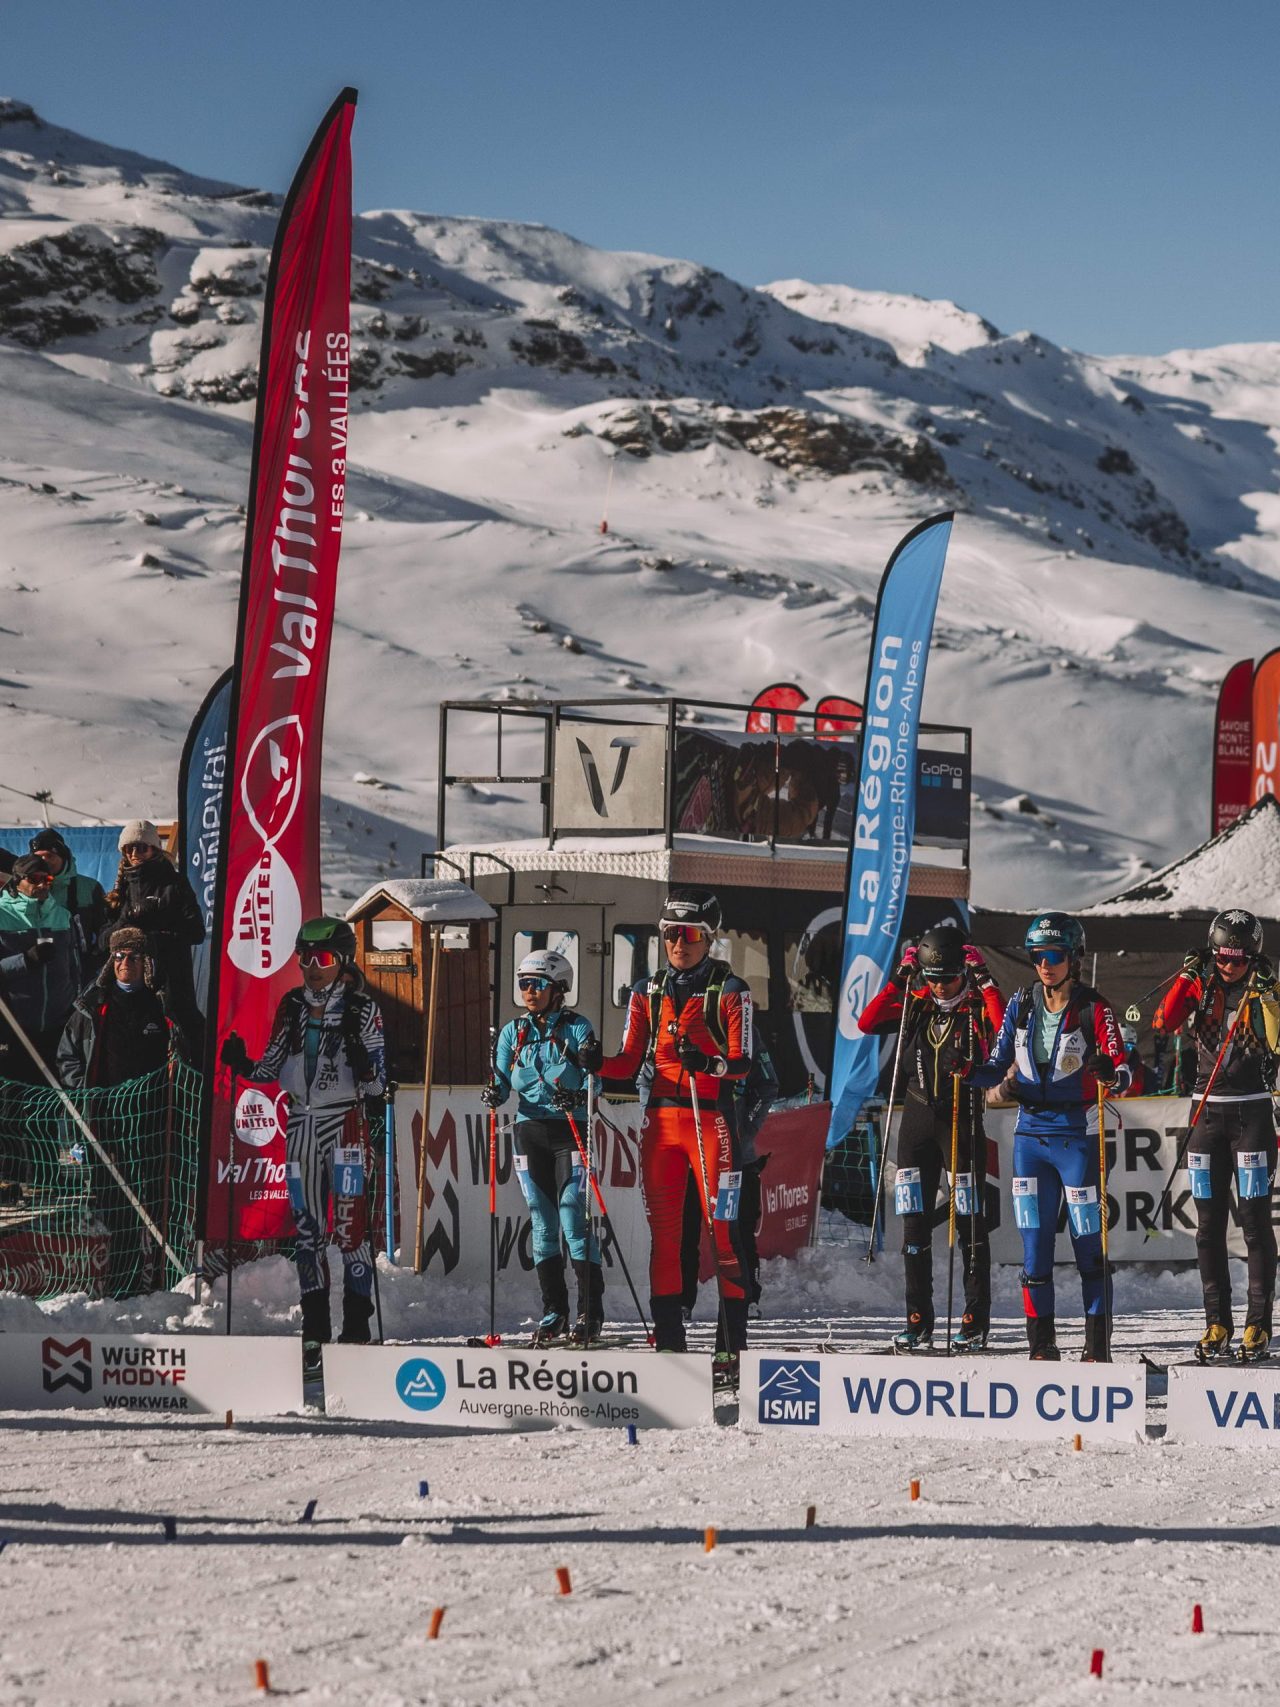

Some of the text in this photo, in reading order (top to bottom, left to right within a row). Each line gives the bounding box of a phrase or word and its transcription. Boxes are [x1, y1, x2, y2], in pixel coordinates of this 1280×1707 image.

[321, 331, 350, 533] LES 3 VALLÉES
[270, 588, 318, 680] Val
[1219, 720, 1250, 732] SAVOIE
[1218, 733, 1244, 744] MONT
[1217, 745, 1250, 757] BLANC
[921, 763, 963, 778] GoPro
[848, 634, 903, 937] La Région
[879, 639, 922, 939] Auvergne-Rhône-Alpes
[257, 850, 273, 969] UNITED
[1103, 1007, 1119, 1057] FRANCE
[242, 1103, 265, 1116] LIVE
[235, 1117, 276, 1130] UNITED
[715, 1115, 731, 1162] Austria
[254, 1157, 287, 1184] Tho
[250, 1190, 290, 1200] LES 3 VALLE
[102, 1346, 187, 1368] WÜRTH
[102, 1367, 187, 1387] MODYF
[456, 1358, 639, 1396] La Région
[103, 1394, 189, 1410] WORKWEAR
[459, 1398, 640, 1421] Auvergne-Rhône-Alpes
[763, 1399, 818, 1424] ISMF
[843, 1376, 1134, 1424] WORLD CUP
